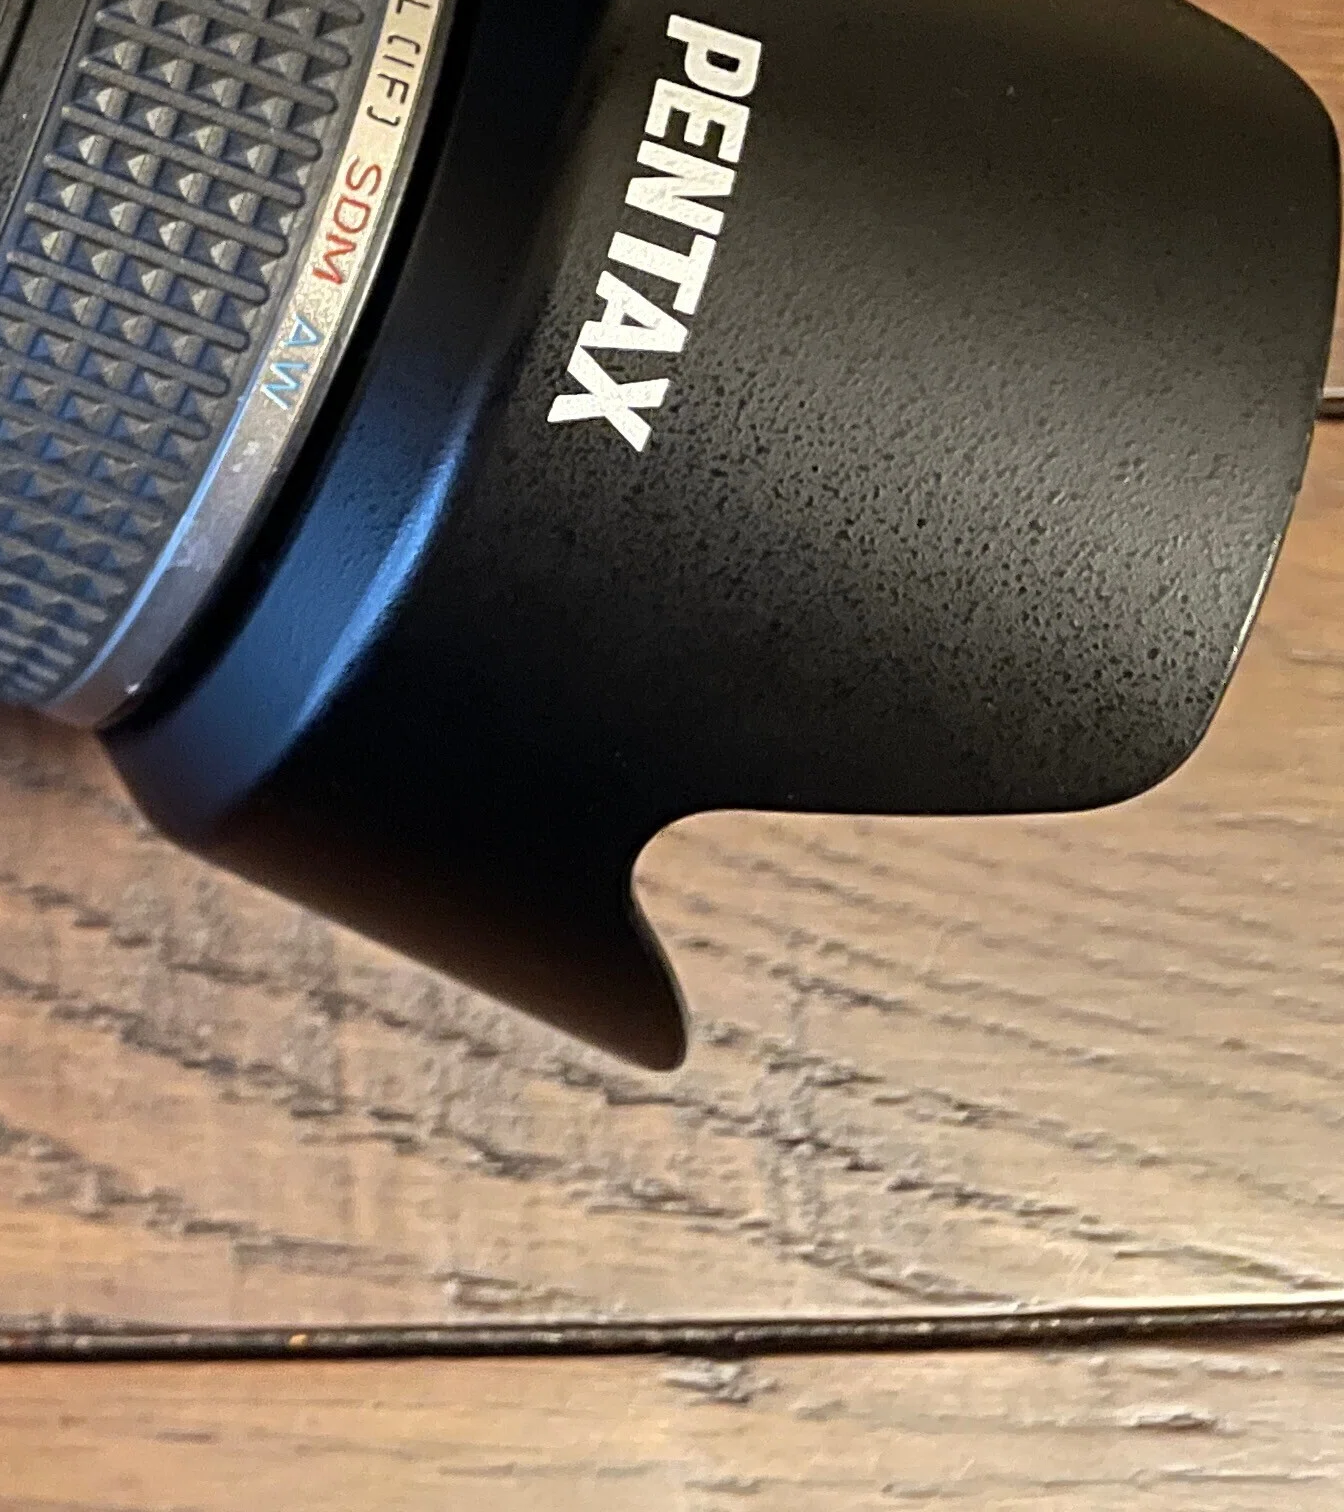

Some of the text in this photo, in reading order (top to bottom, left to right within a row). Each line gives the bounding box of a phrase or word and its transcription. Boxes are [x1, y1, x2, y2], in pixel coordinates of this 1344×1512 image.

[311, 153, 383, 286] SDM
[546, 13, 764, 453] PENTAX
[260, 311, 324, 412] AW
